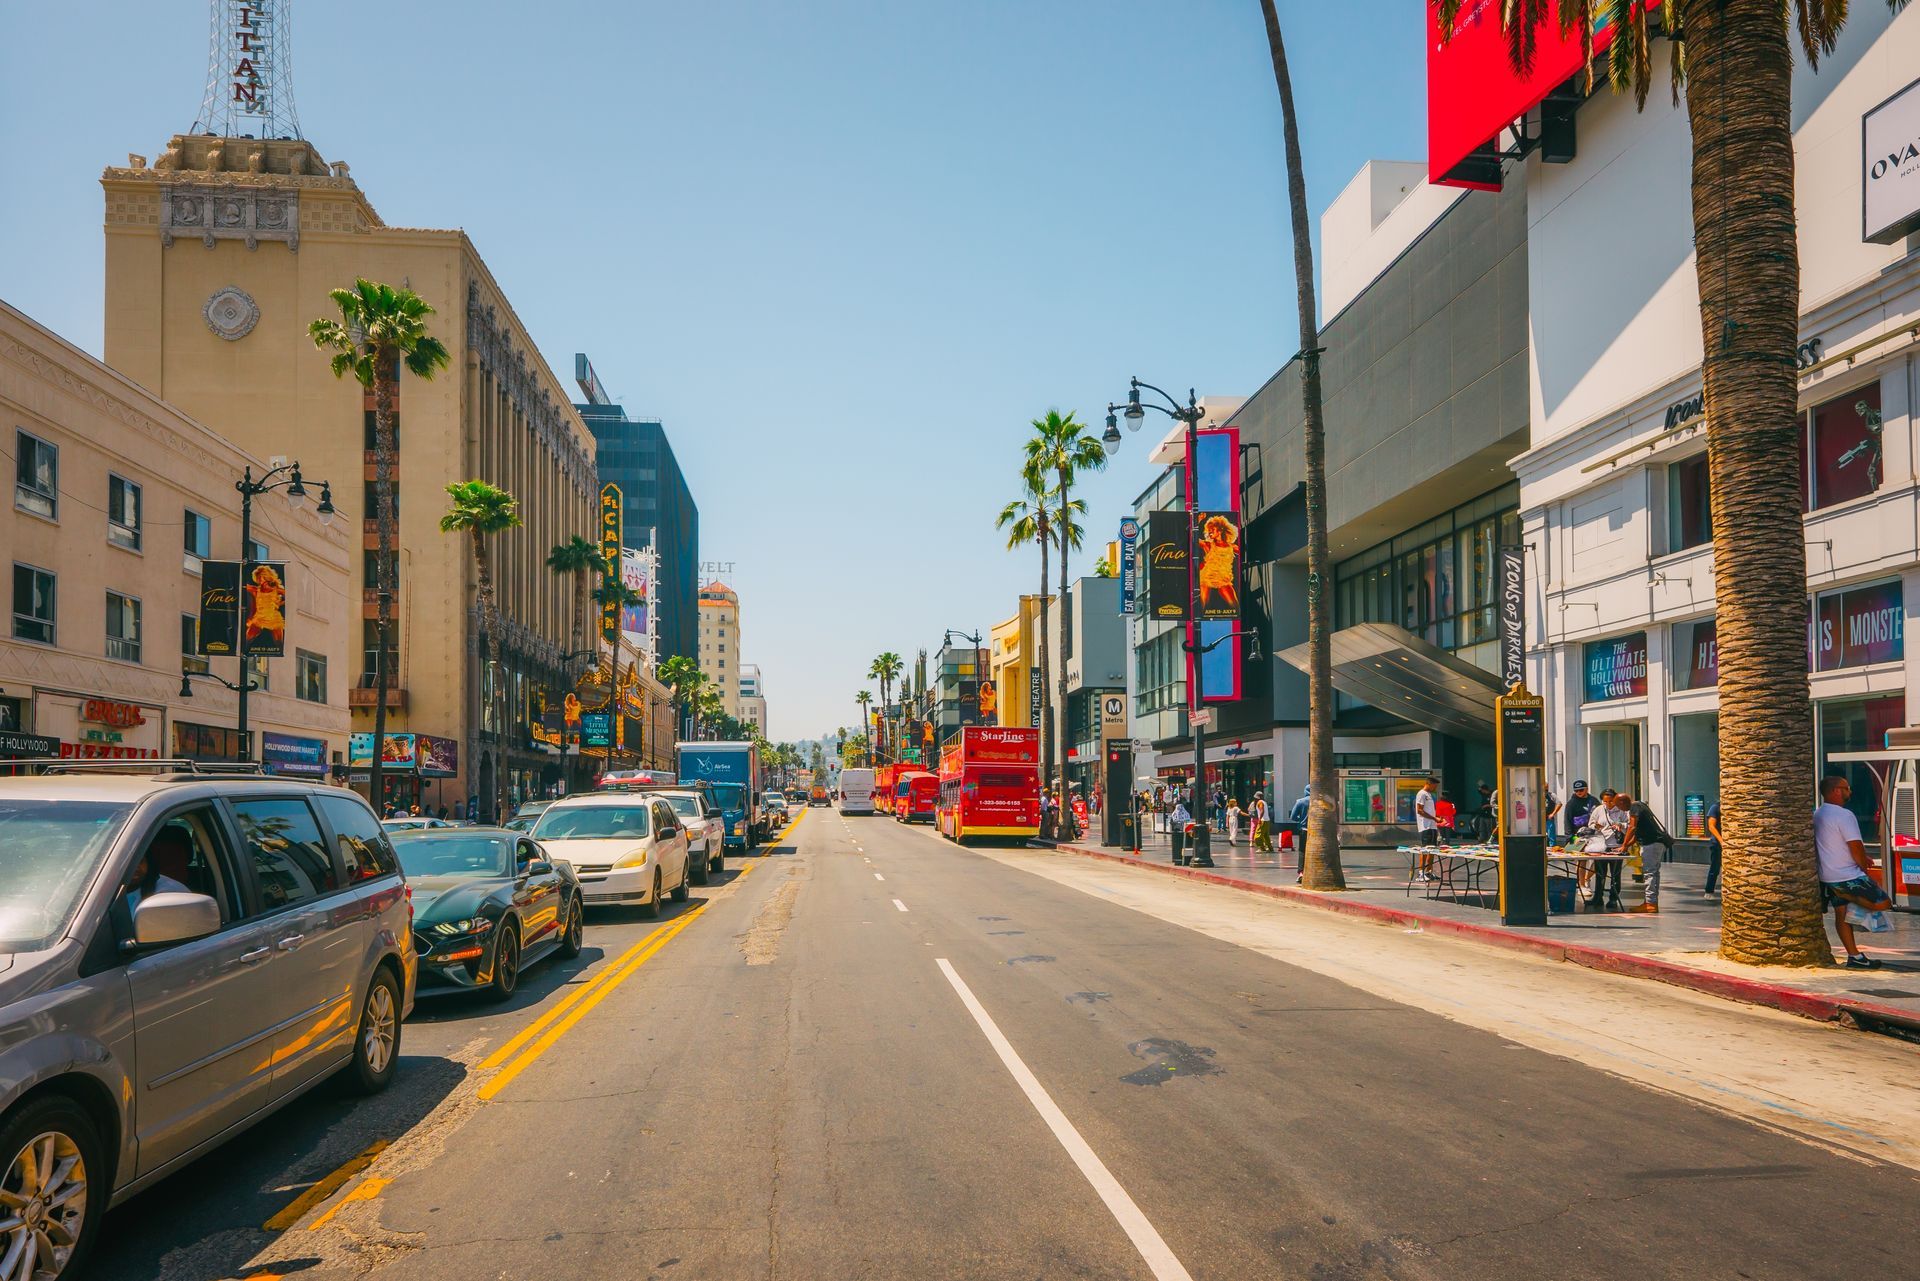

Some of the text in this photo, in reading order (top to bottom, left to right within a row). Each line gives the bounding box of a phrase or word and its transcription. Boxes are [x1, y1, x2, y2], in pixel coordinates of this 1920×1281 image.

[233, 0, 257, 102] ITAN
[1871, 137, 1920, 180] OVA
[603, 495, 618, 509] EL
[1125, 543, 1135, 561] PLAY
[1150, 543, 1188, 564] Tina
[604, 512, 618, 629] CAPIAN
[1504, 553, 1523, 603] ICONS
[1125, 570, 1134, 591] DRINK
[202, 588, 237, 607] Tina
[1125, 600, 1134, 612] EAT
[1613, 642, 1627, 655] THE
[1592, 649, 1645, 672] ULTIMATE
[1591, 664, 1646, 686] HOLLYWOOD
[1031, 672, 1040, 712] THEATRE
[1603, 681, 1632, 697] TOUR
[1108, 701, 1121, 713] M
[6, 737, 49, 752] HOLLYWOOD
[60, 742, 159, 759] PIZZERIA
[264, 742, 290, 752] HOLLYWOOD
